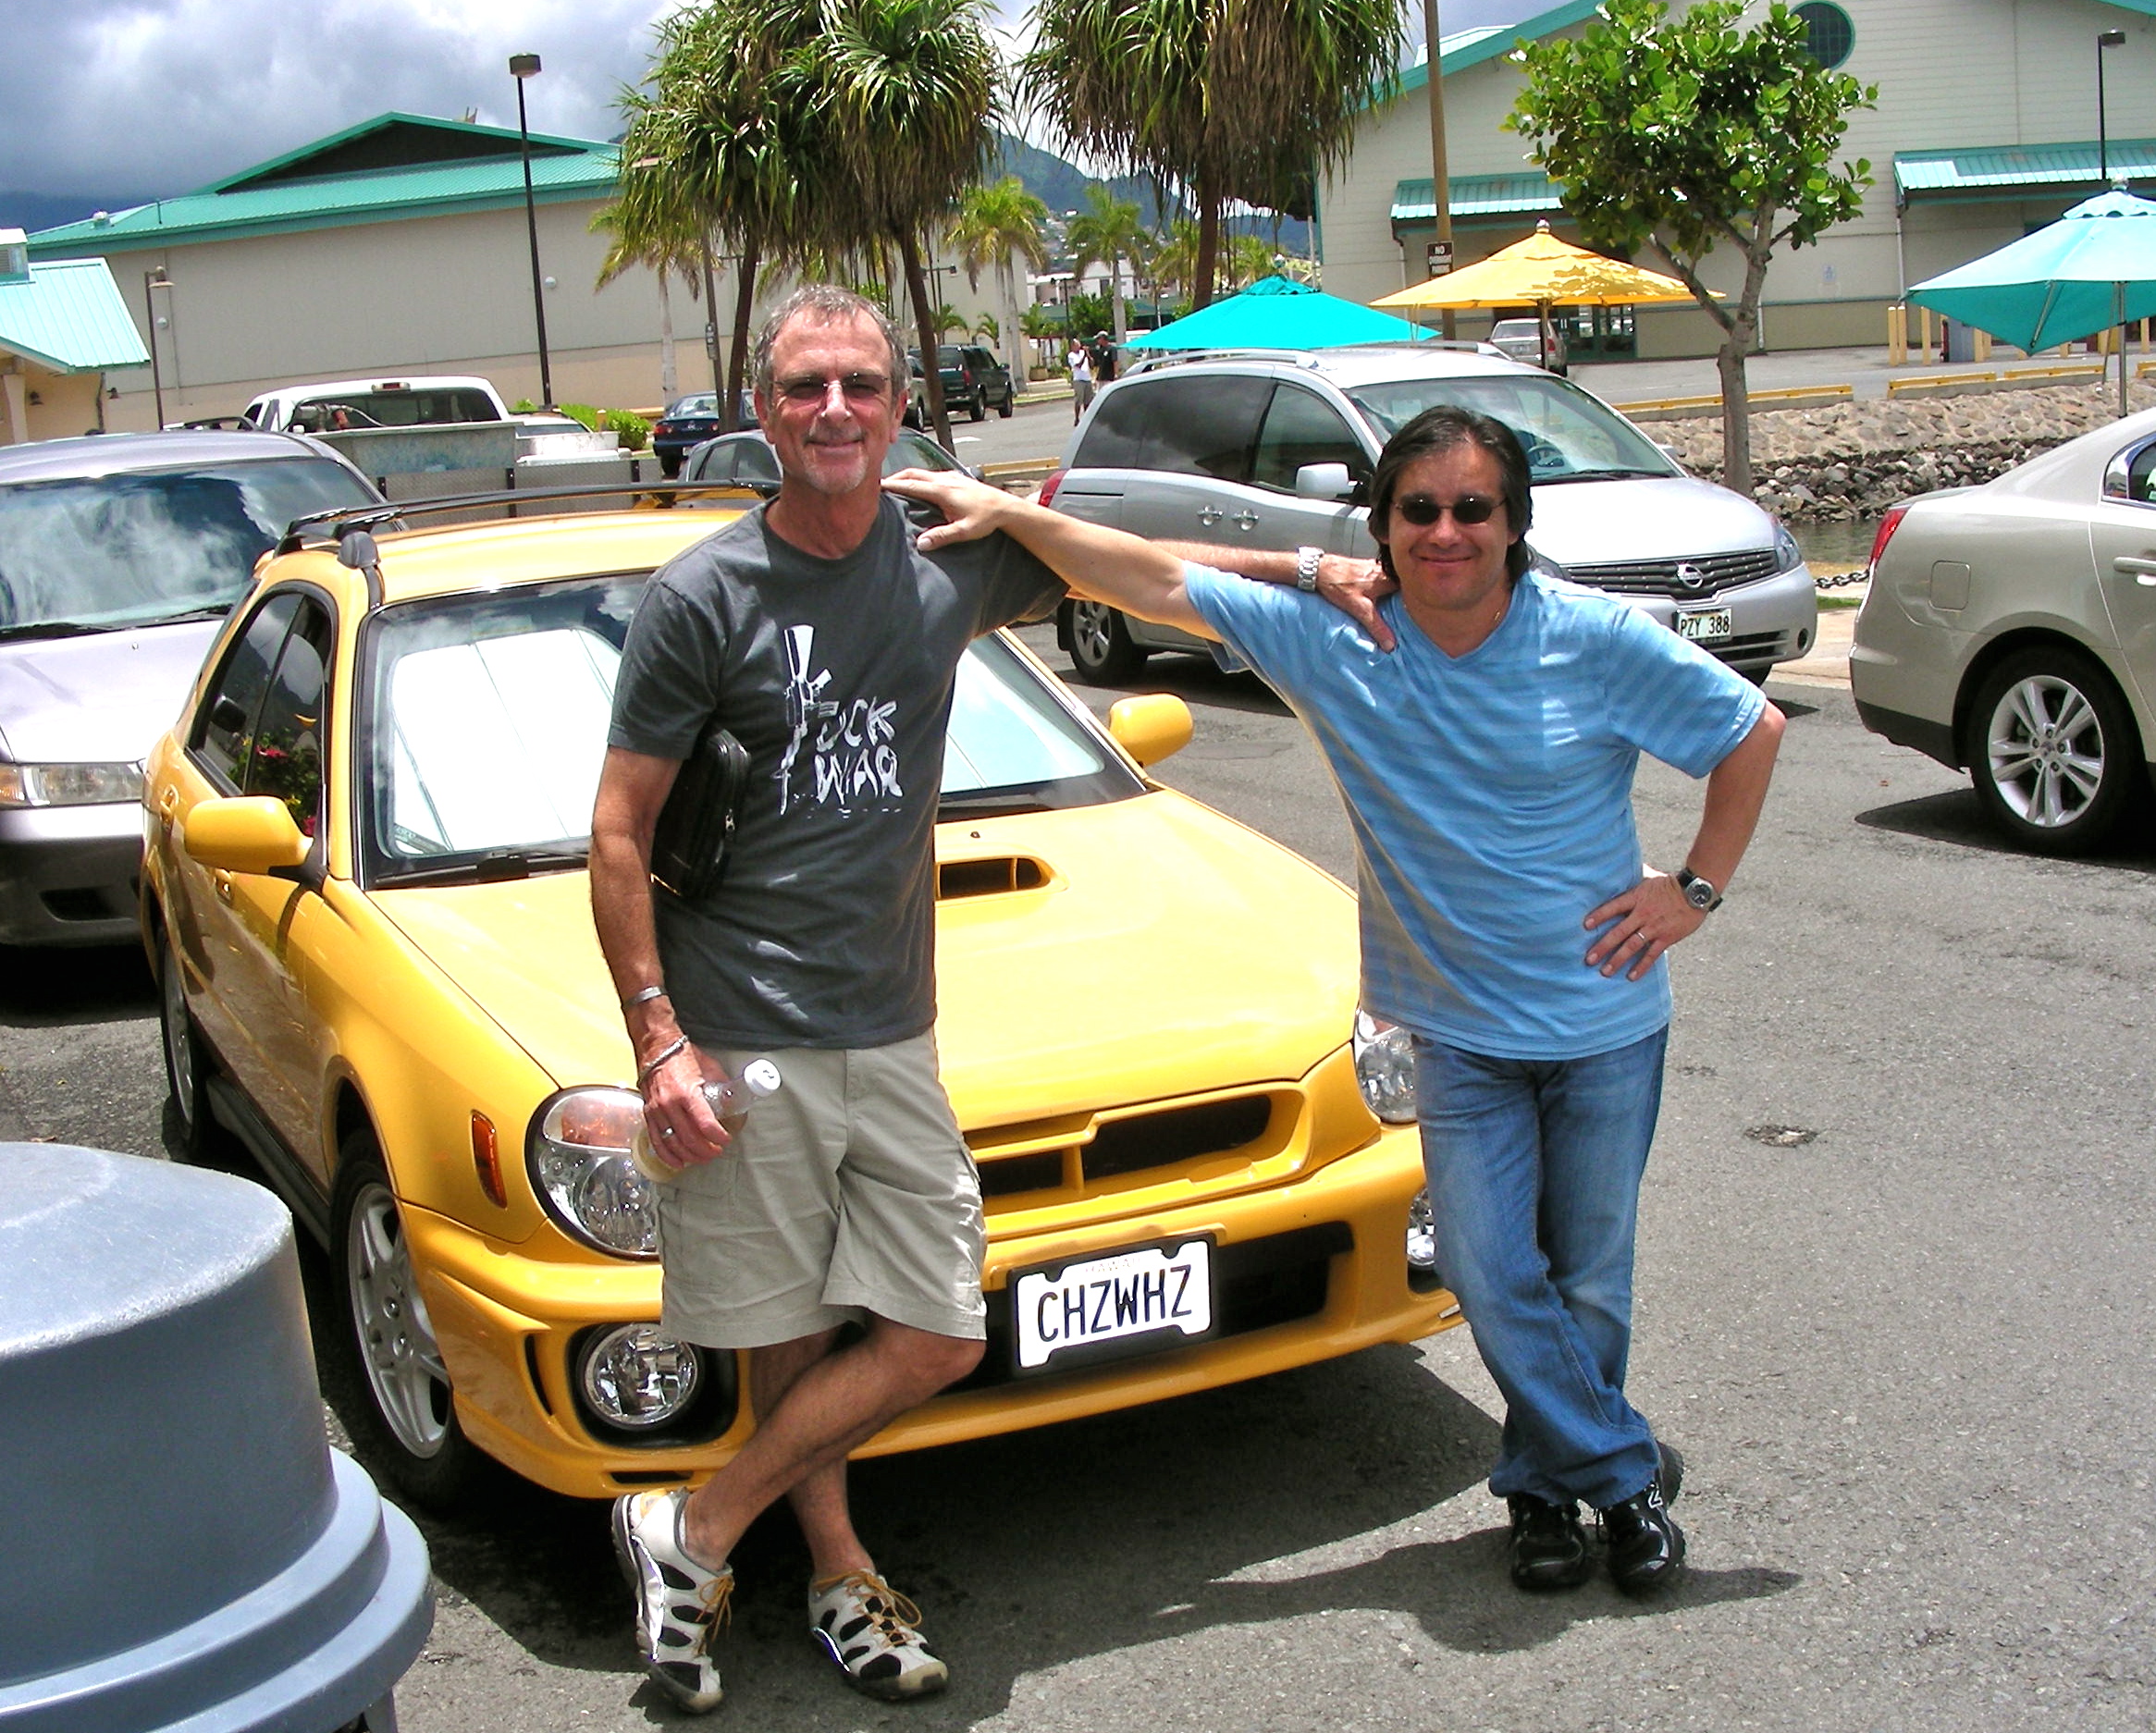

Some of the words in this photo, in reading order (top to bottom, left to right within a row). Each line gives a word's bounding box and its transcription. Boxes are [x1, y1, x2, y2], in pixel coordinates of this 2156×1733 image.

[1435, 245, 1445, 255] NO
[1680, 617, 1702, 637] PZY
[1708, 615, 1730, 634] 388
[1037, 1264, 1192, 1342] CHZWHZ
